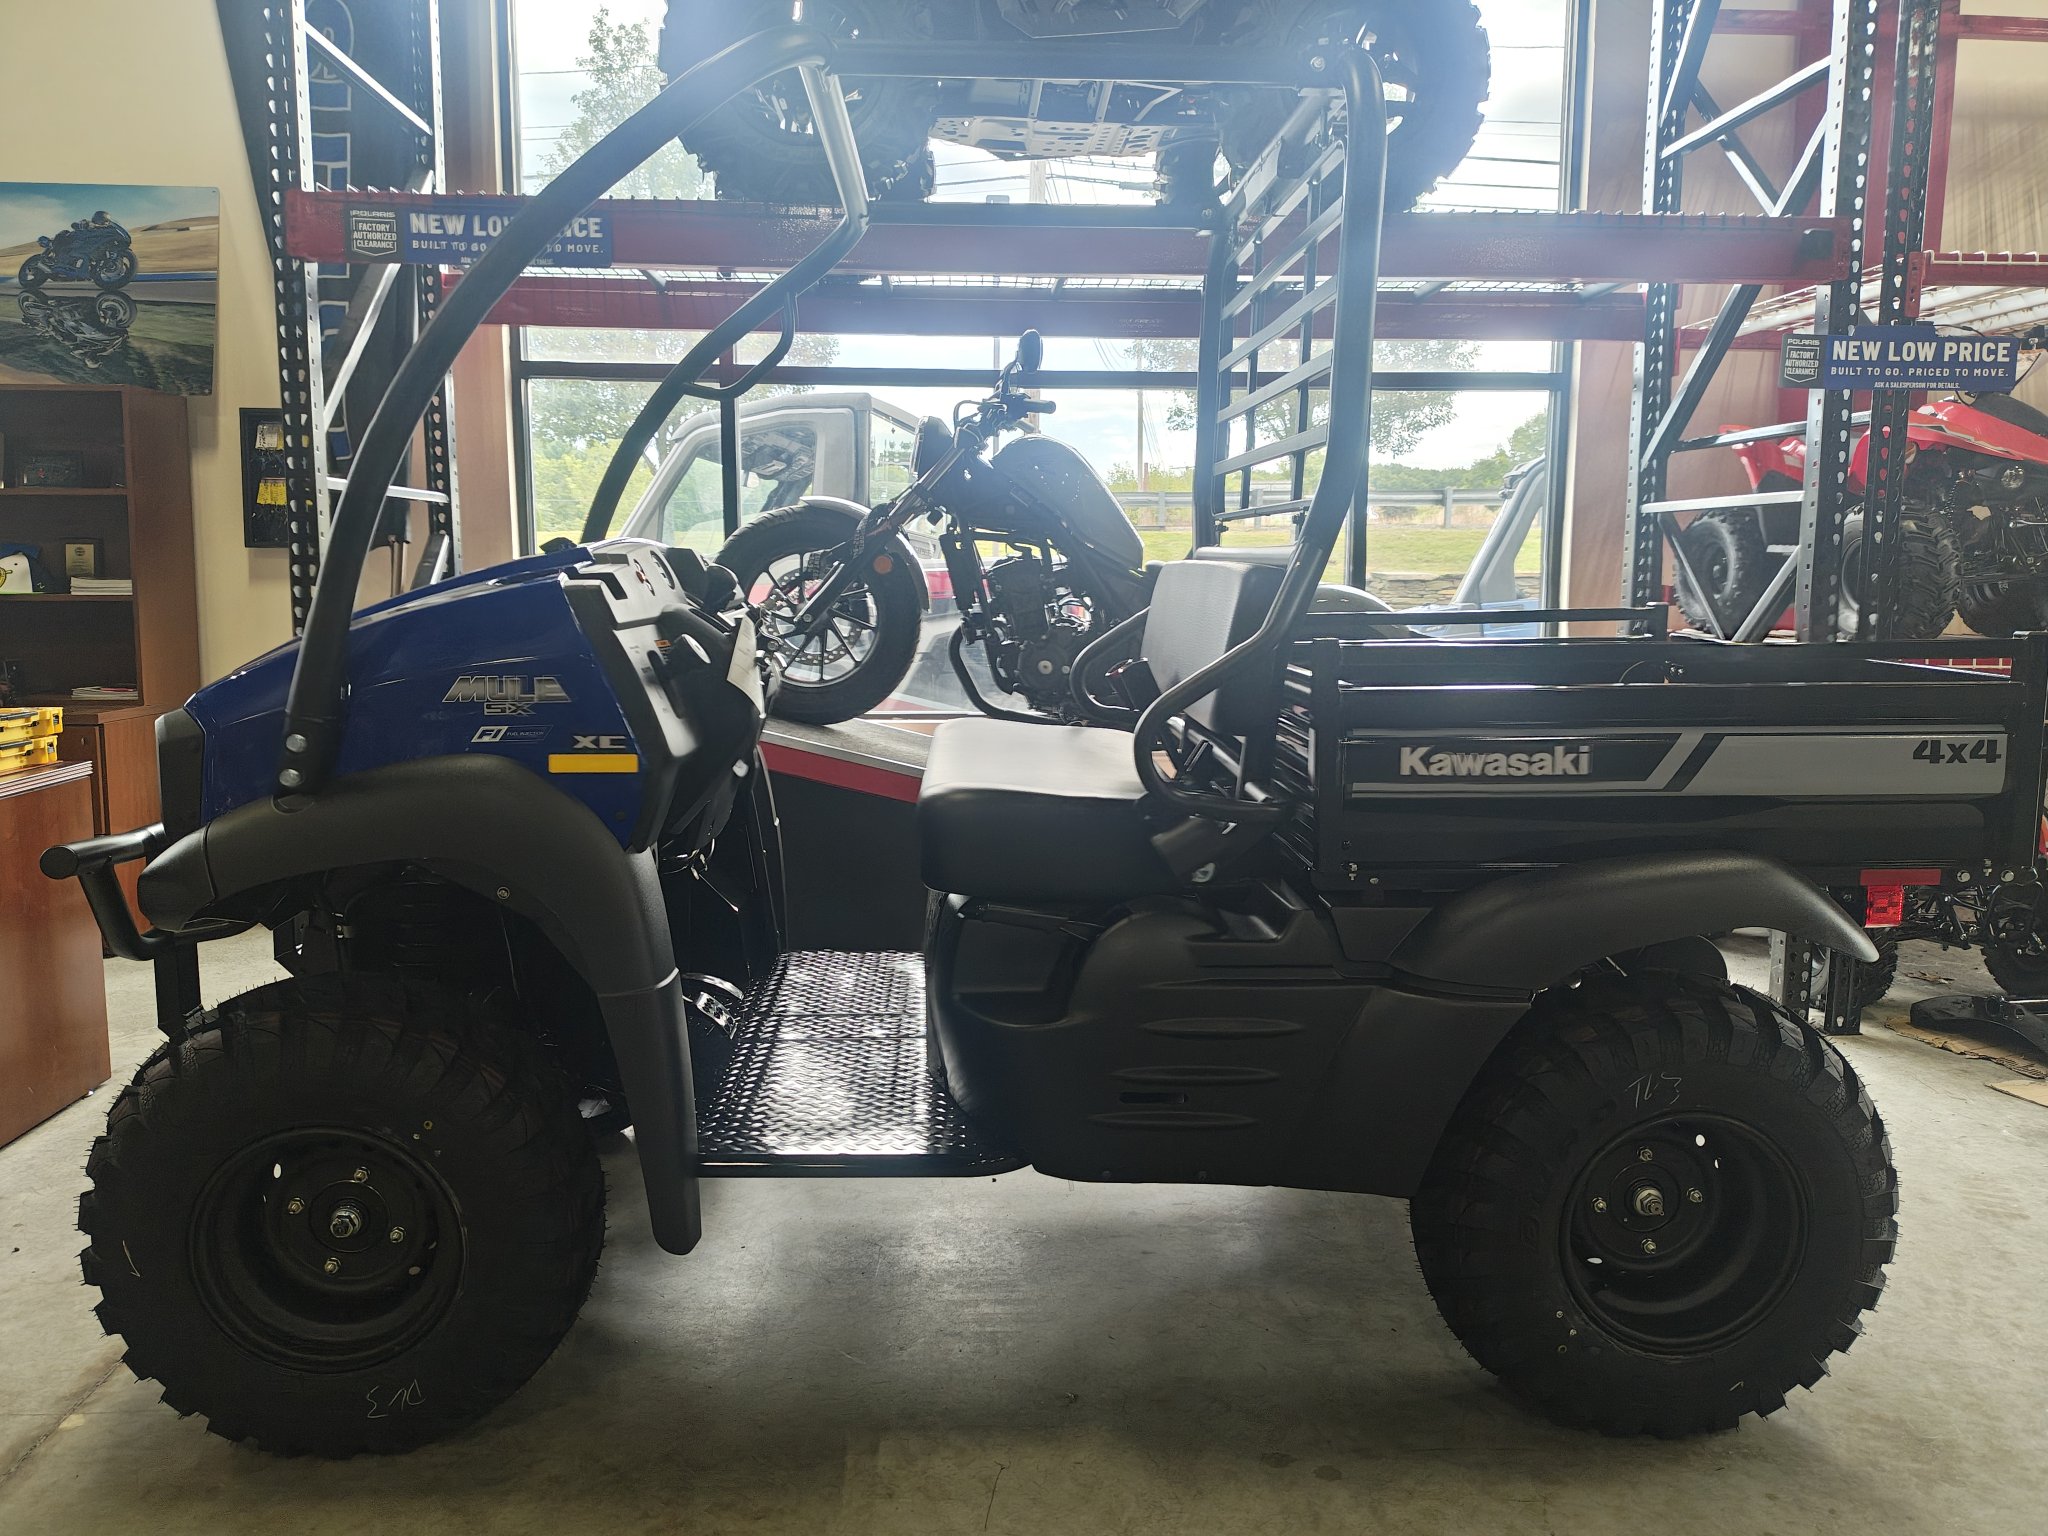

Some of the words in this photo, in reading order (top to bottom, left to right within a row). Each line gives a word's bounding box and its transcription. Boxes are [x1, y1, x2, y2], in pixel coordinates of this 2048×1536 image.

[350, 210, 396, 218] POLARIS
[358, 222, 391, 232] FACTORY
[410, 213, 466, 236] NEW
[353, 231, 397, 241] AUTHORIZED
[356, 239, 394, 249] CLEARANCE
[412, 240, 447, 250] BUILT
[451, 241, 468, 252] TO
[567, 244, 604, 254] MOVE.
[1787, 338, 1820, 346] POLARIS
[1789, 350, 1815, 360] FACTORY
[1832, 340, 1882, 361] NEW
[1888, 341, 1938, 362] LOW
[1943, 342, 2011, 363] PRICE
[1785, 359, 1819, 368] AUTHORIZED
[1786, 367, 1815, 376] CLEARANCE
[1830, 366, 1862, 376] BUILT
[1867, 367, 1881, 376] TO
[1885, 367, 1904, 377] GO.
[1908, 367, 1950, 377] PRICED
[1954, 368, 1969, 377] TO
[1973, 368, 2009, 377] MOVE.
[1874, 381, 1885, 389] ASK
[1885, 381, 1890, 389] A
[1890, 381, 1926, 389] SALESPERSON
[442, 675, 573, 703] MULE
[483, 702, 537, 716] SX
[573, 735, 628, 749] XC
[1912, 739, 2002, 764] 4x4
[1400, 745, 1591, 777] Kawasaki
